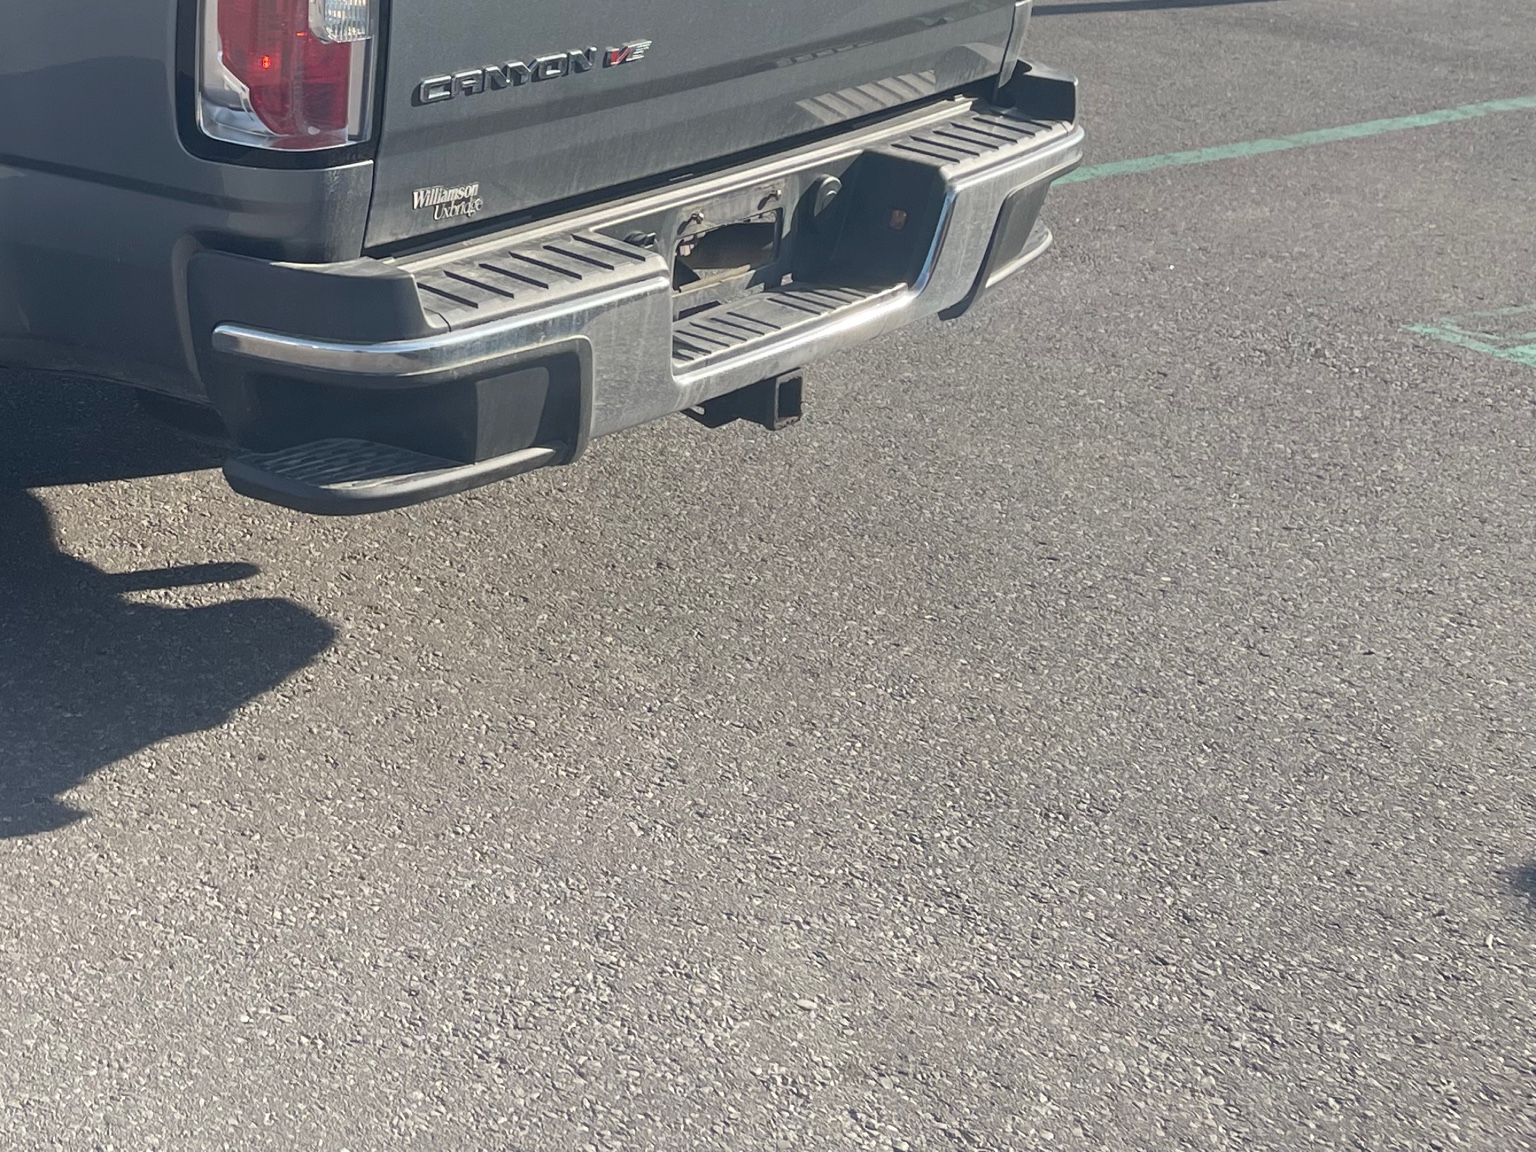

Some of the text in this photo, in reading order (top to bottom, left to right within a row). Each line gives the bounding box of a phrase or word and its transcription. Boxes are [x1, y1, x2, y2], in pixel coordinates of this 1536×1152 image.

[418, 47, 597, 103] CANYON
[412, 182, 480, 209] Williamson
[434, 196, 484, 221] Uxbridge
